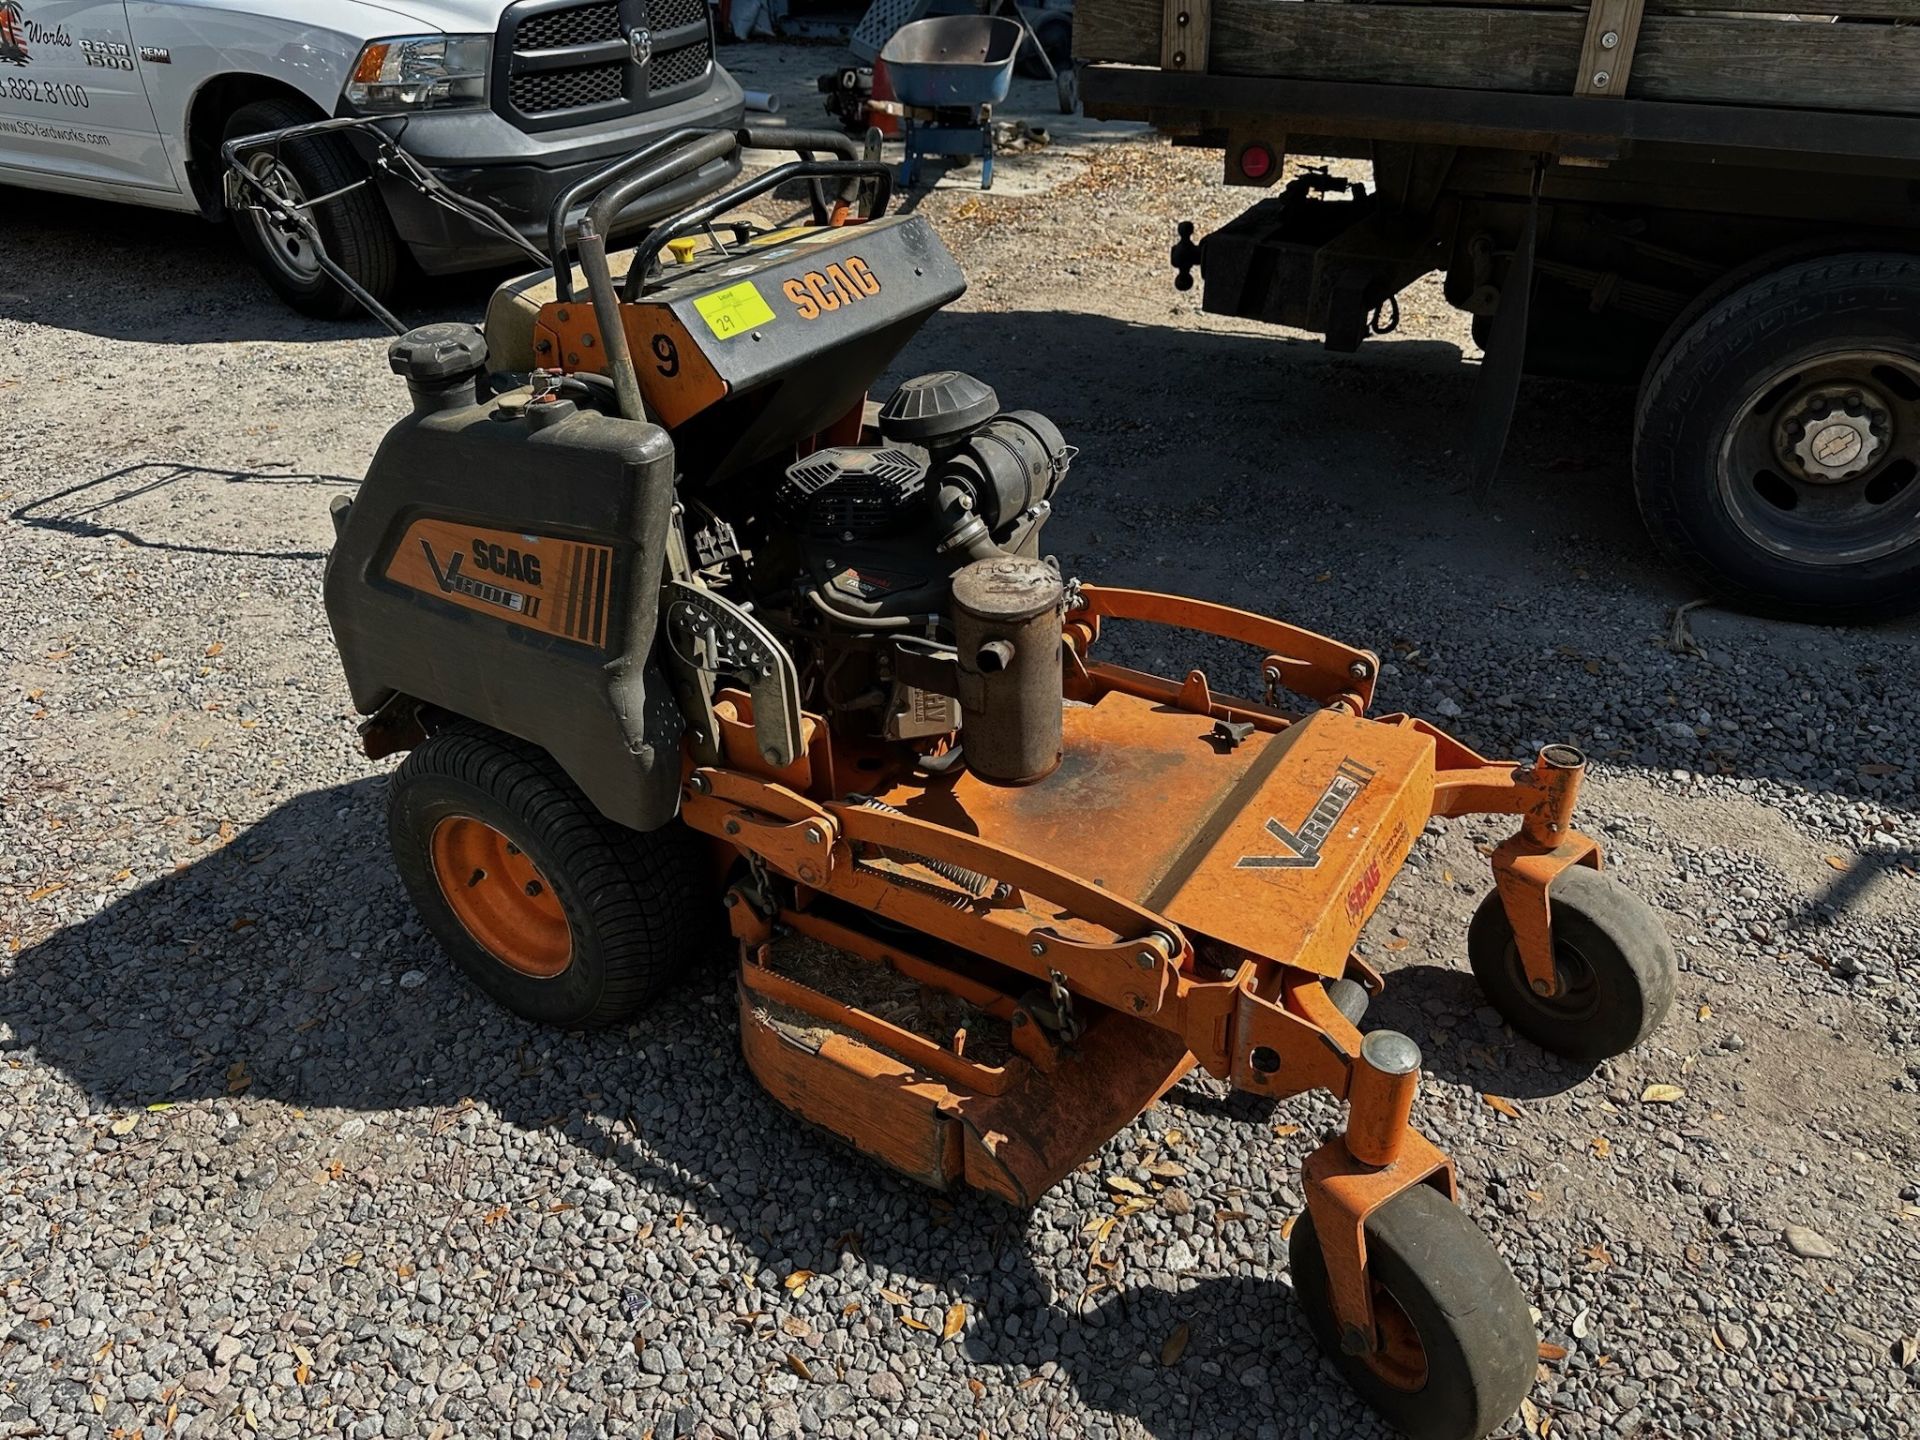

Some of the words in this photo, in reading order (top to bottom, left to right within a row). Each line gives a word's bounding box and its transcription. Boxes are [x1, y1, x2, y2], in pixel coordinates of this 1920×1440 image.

[24, 20, 73, 47] Works
[78, 39, 131, 57] RAM
[138, 46, 169, 57] HEMI
[82, 53, 134, 71] 1500
[782, 255, 882, 321] SCAG
[716, 315, 735, 332] 29
[651, 333, 680, 379] 9
[472, 538, 543, 586] SCAG
[975, 562, 1038, 575] HOT
